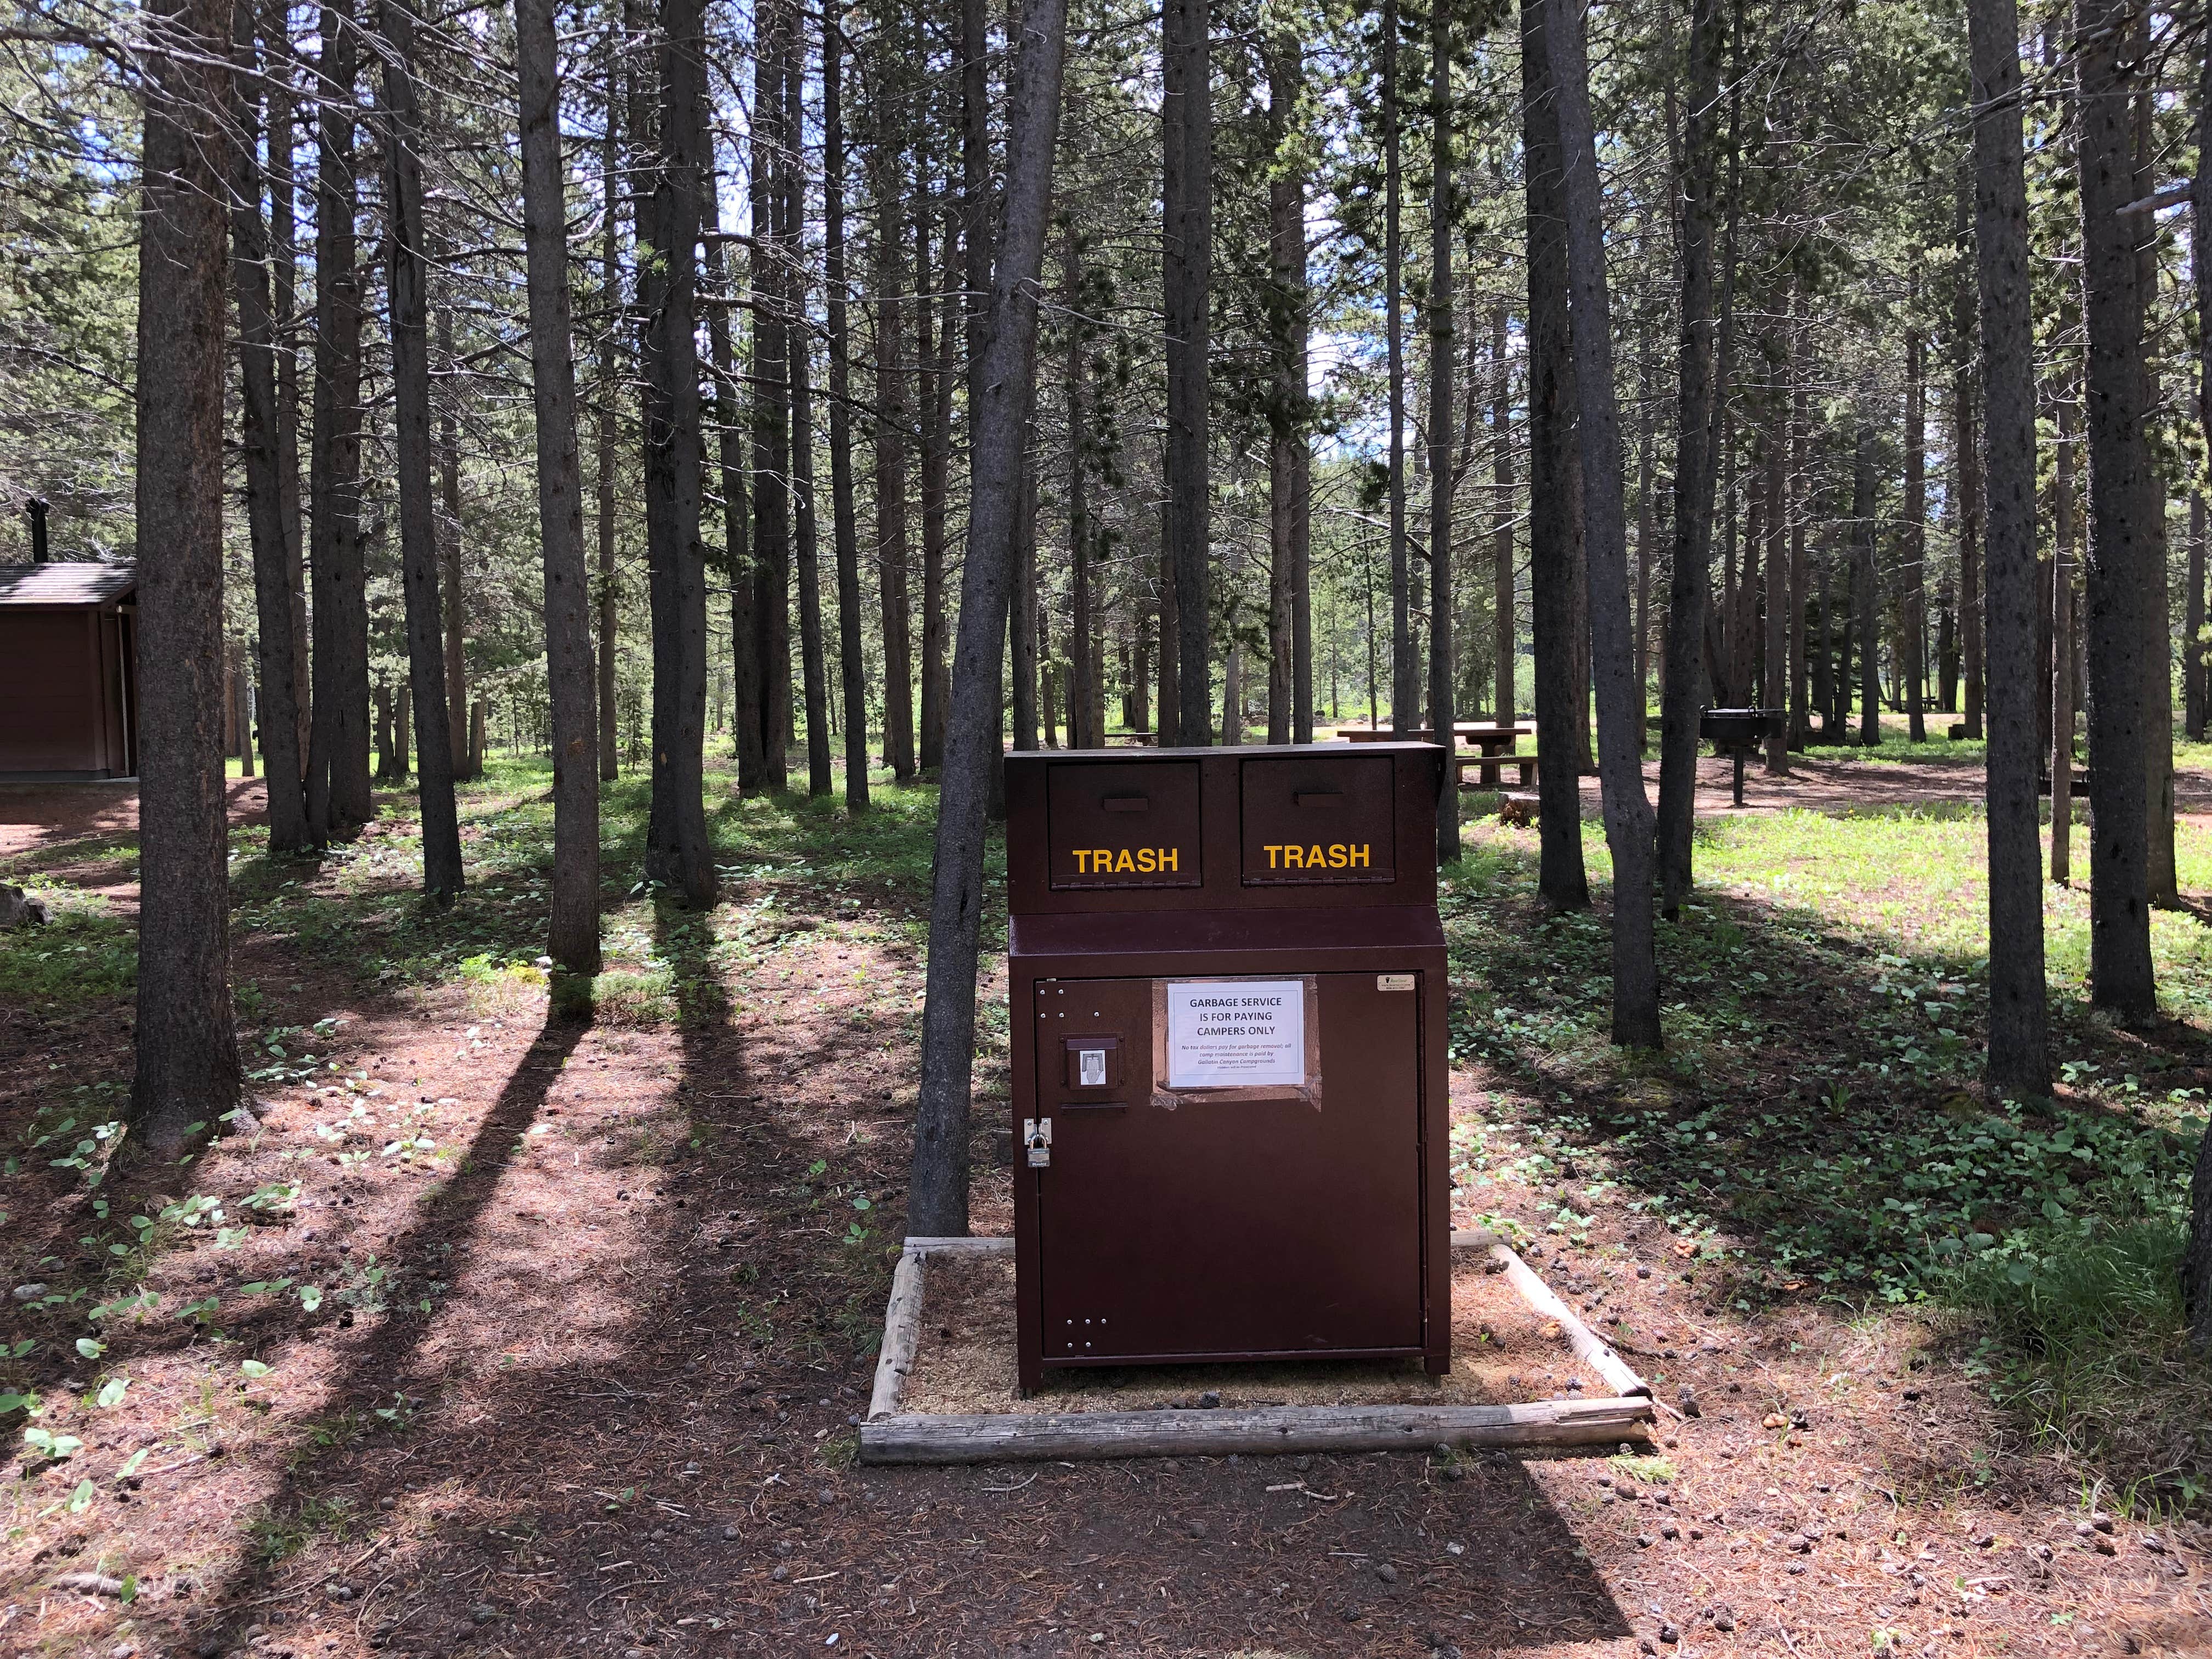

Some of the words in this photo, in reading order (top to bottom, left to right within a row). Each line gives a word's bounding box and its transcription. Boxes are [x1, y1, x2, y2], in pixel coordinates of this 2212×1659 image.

[1073, 848, 1178, 873] TRASH
[1264, 844, 1370, 868] TRASH
[1190, 998, 1238, 1007] GARBAGE
[1242, 998, 1282, 1006] SERVICE
[1211, 1013, 1231, 1021] FOR
[1234, 1012, 1272, 1020] PAYING
[1198, 1027, 1245, 1035] CAMPERS
[1248, 1026, 1275, 1035] ONLY
